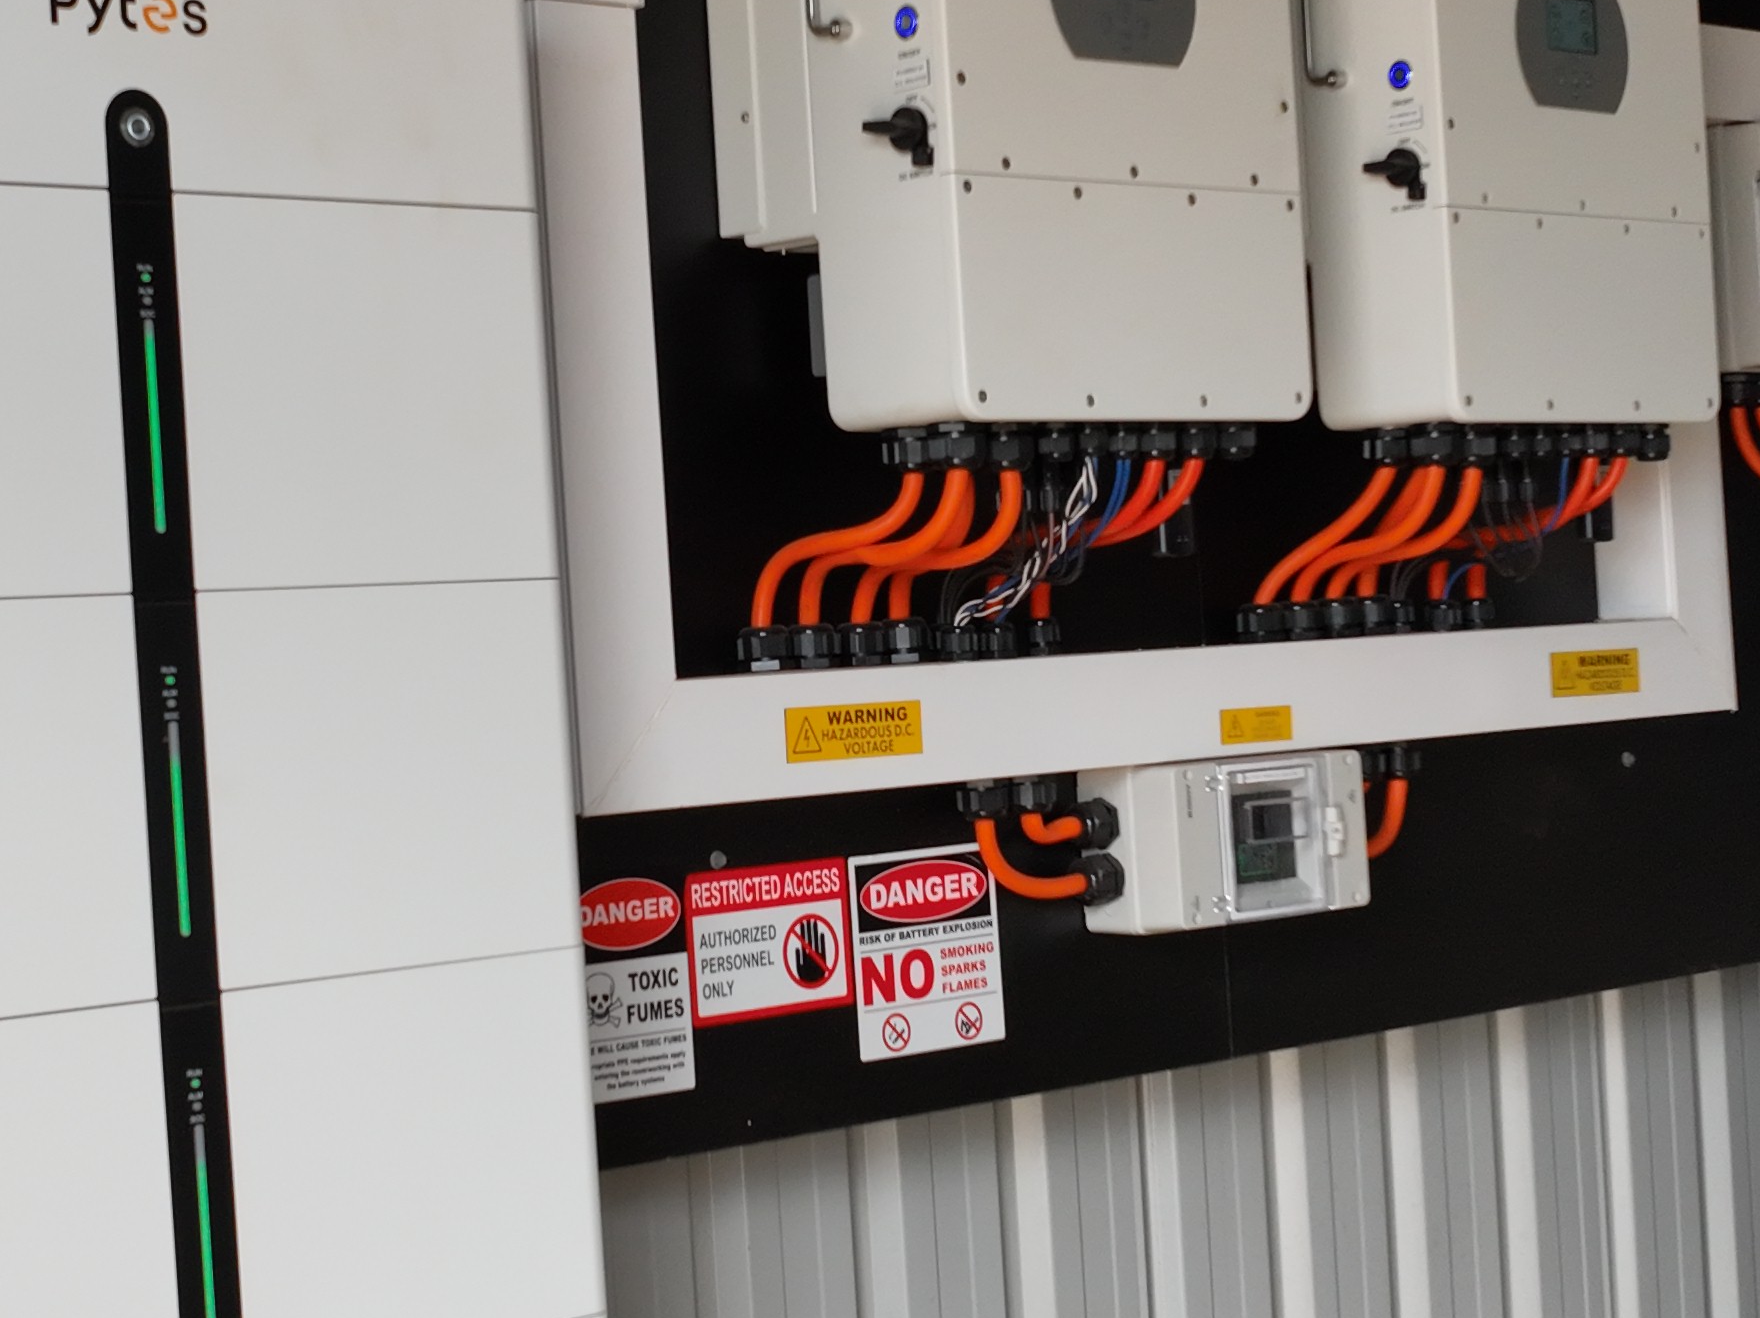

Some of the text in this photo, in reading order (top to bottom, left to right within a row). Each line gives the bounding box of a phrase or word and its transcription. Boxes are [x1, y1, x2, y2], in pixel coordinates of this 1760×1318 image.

[827, 707, 908, 726] WARNING
[822, 725, 891, 742] HAZARDOUS
[844, 739, 894, 755] VOLTAGE
[691, 867, 840, 909] RESTRICTED ACCESS
[868, 871, 979, 910] DANGER
[581, 895, 675, 928] DANGER
[699, 924, 777, 950] AUTHORIZED
[859, 919, 993, 946] RISK OF BATTERY EXPLOSION
[701, 950, 775, 974] PERSONNEL
[939, 941, 994, 959] SMOKING
[628, 967, 679, 992] TOXIC
[861, 948, 935, 1006] NO
[941, 960, 986, 977] SPARKS
[702, 980, 735, 1000] ONLY
[942, 977, 988, 993] FLAMES
[627, 998, 685, 1024] FUMES
